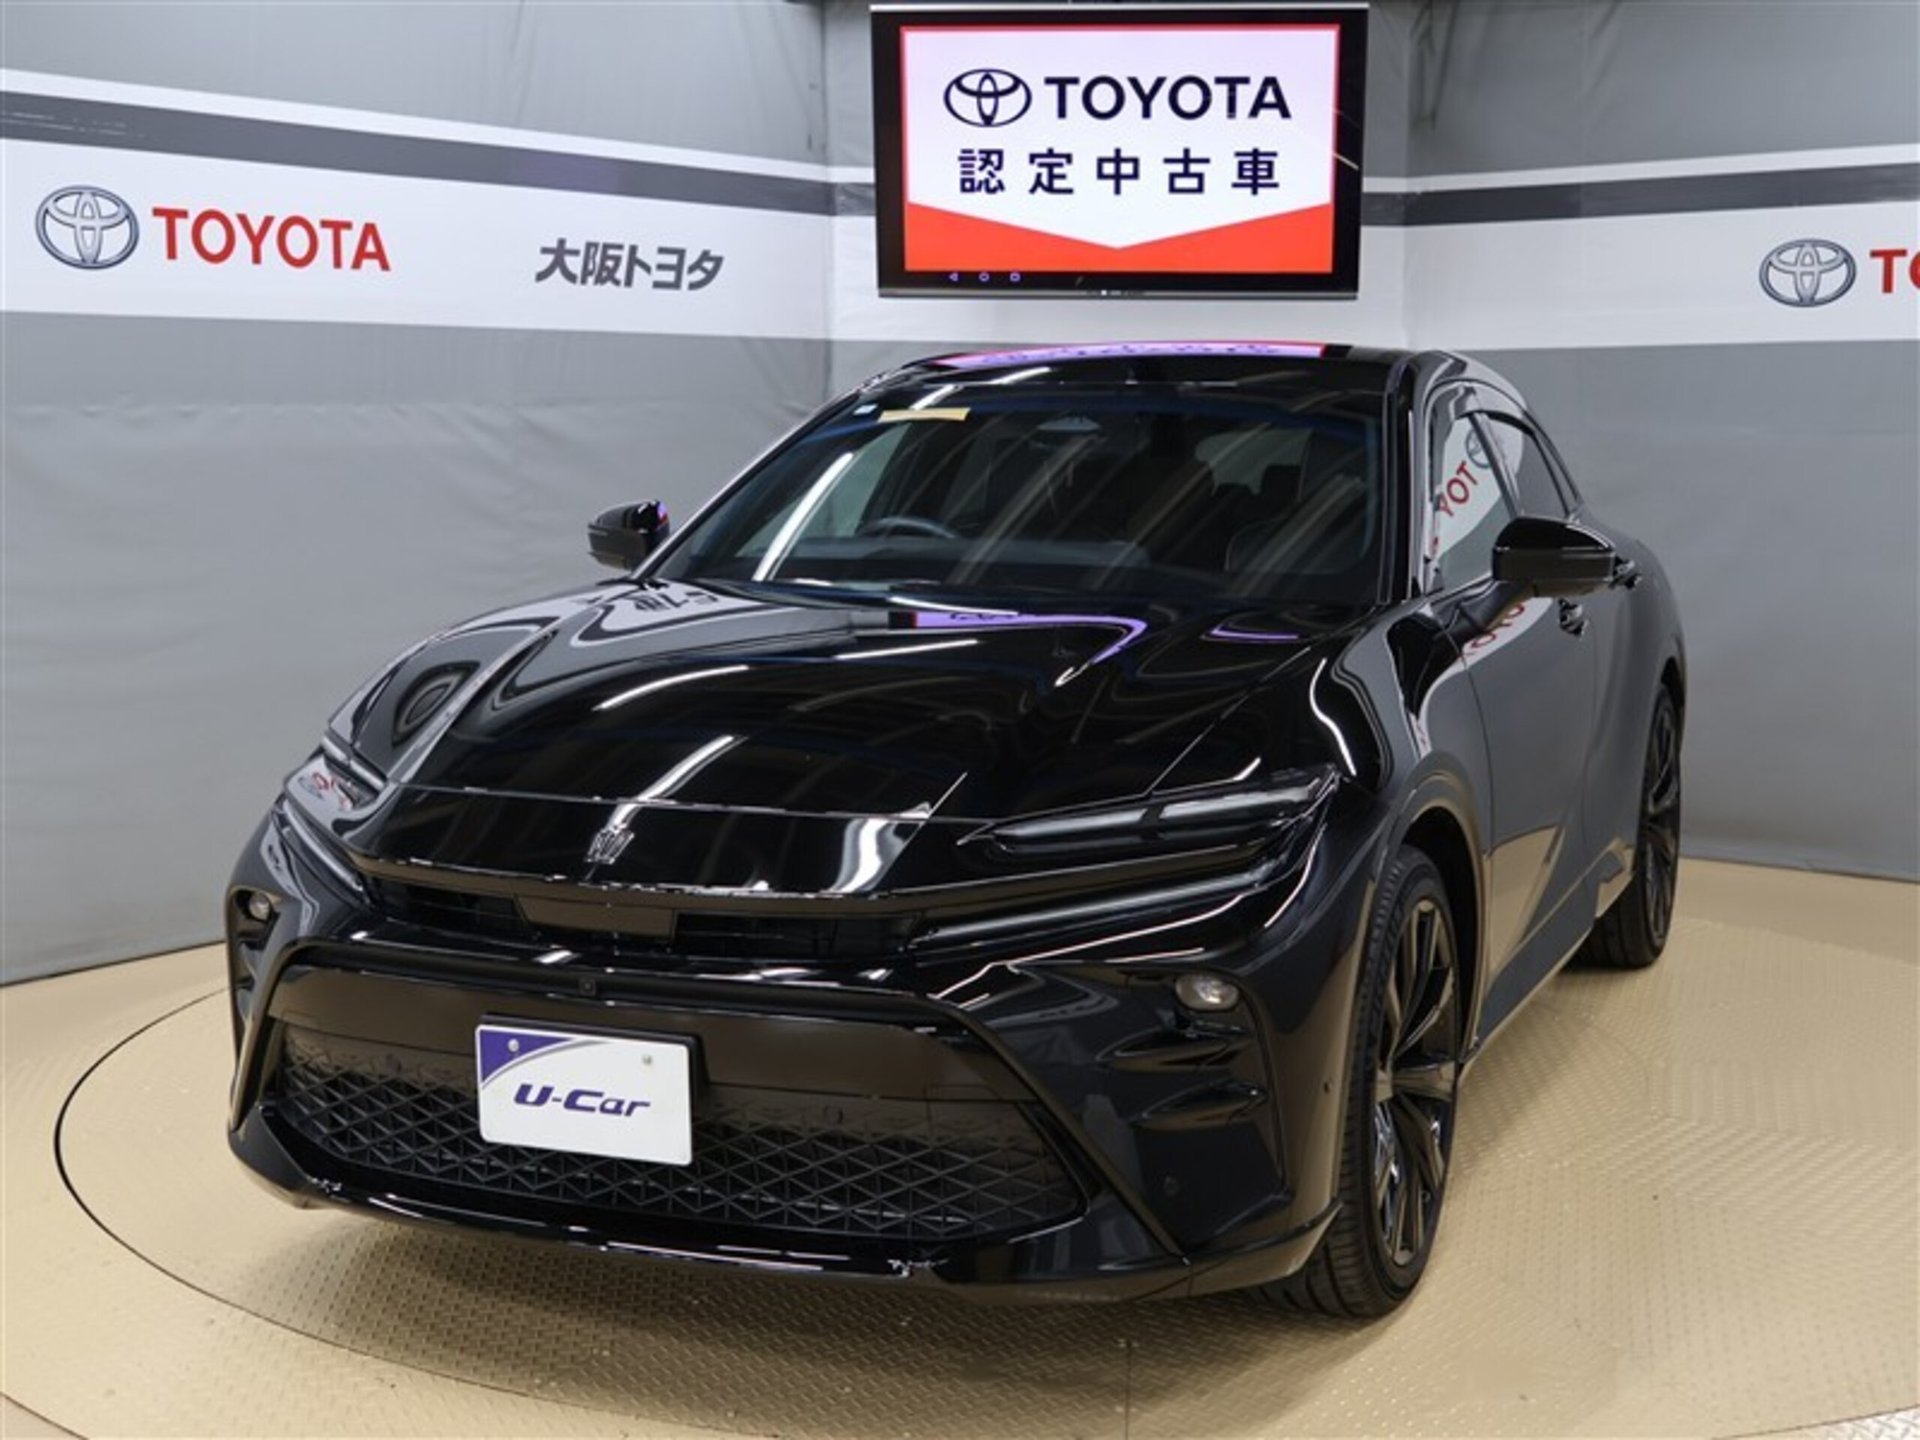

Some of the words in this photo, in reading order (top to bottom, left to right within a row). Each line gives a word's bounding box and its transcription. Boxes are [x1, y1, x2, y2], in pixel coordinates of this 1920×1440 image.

[1044, 75, 1292, 121] TOYOTA
[958, 147, 1280, 196] 認定中古車
[153, 206, 390, 271] TOYOTA
[535, 237, 724, 291] 大阪トヨタ
[1869, 248, 1920, 294] T
[513, 1083, 651, 1118] U-Car
